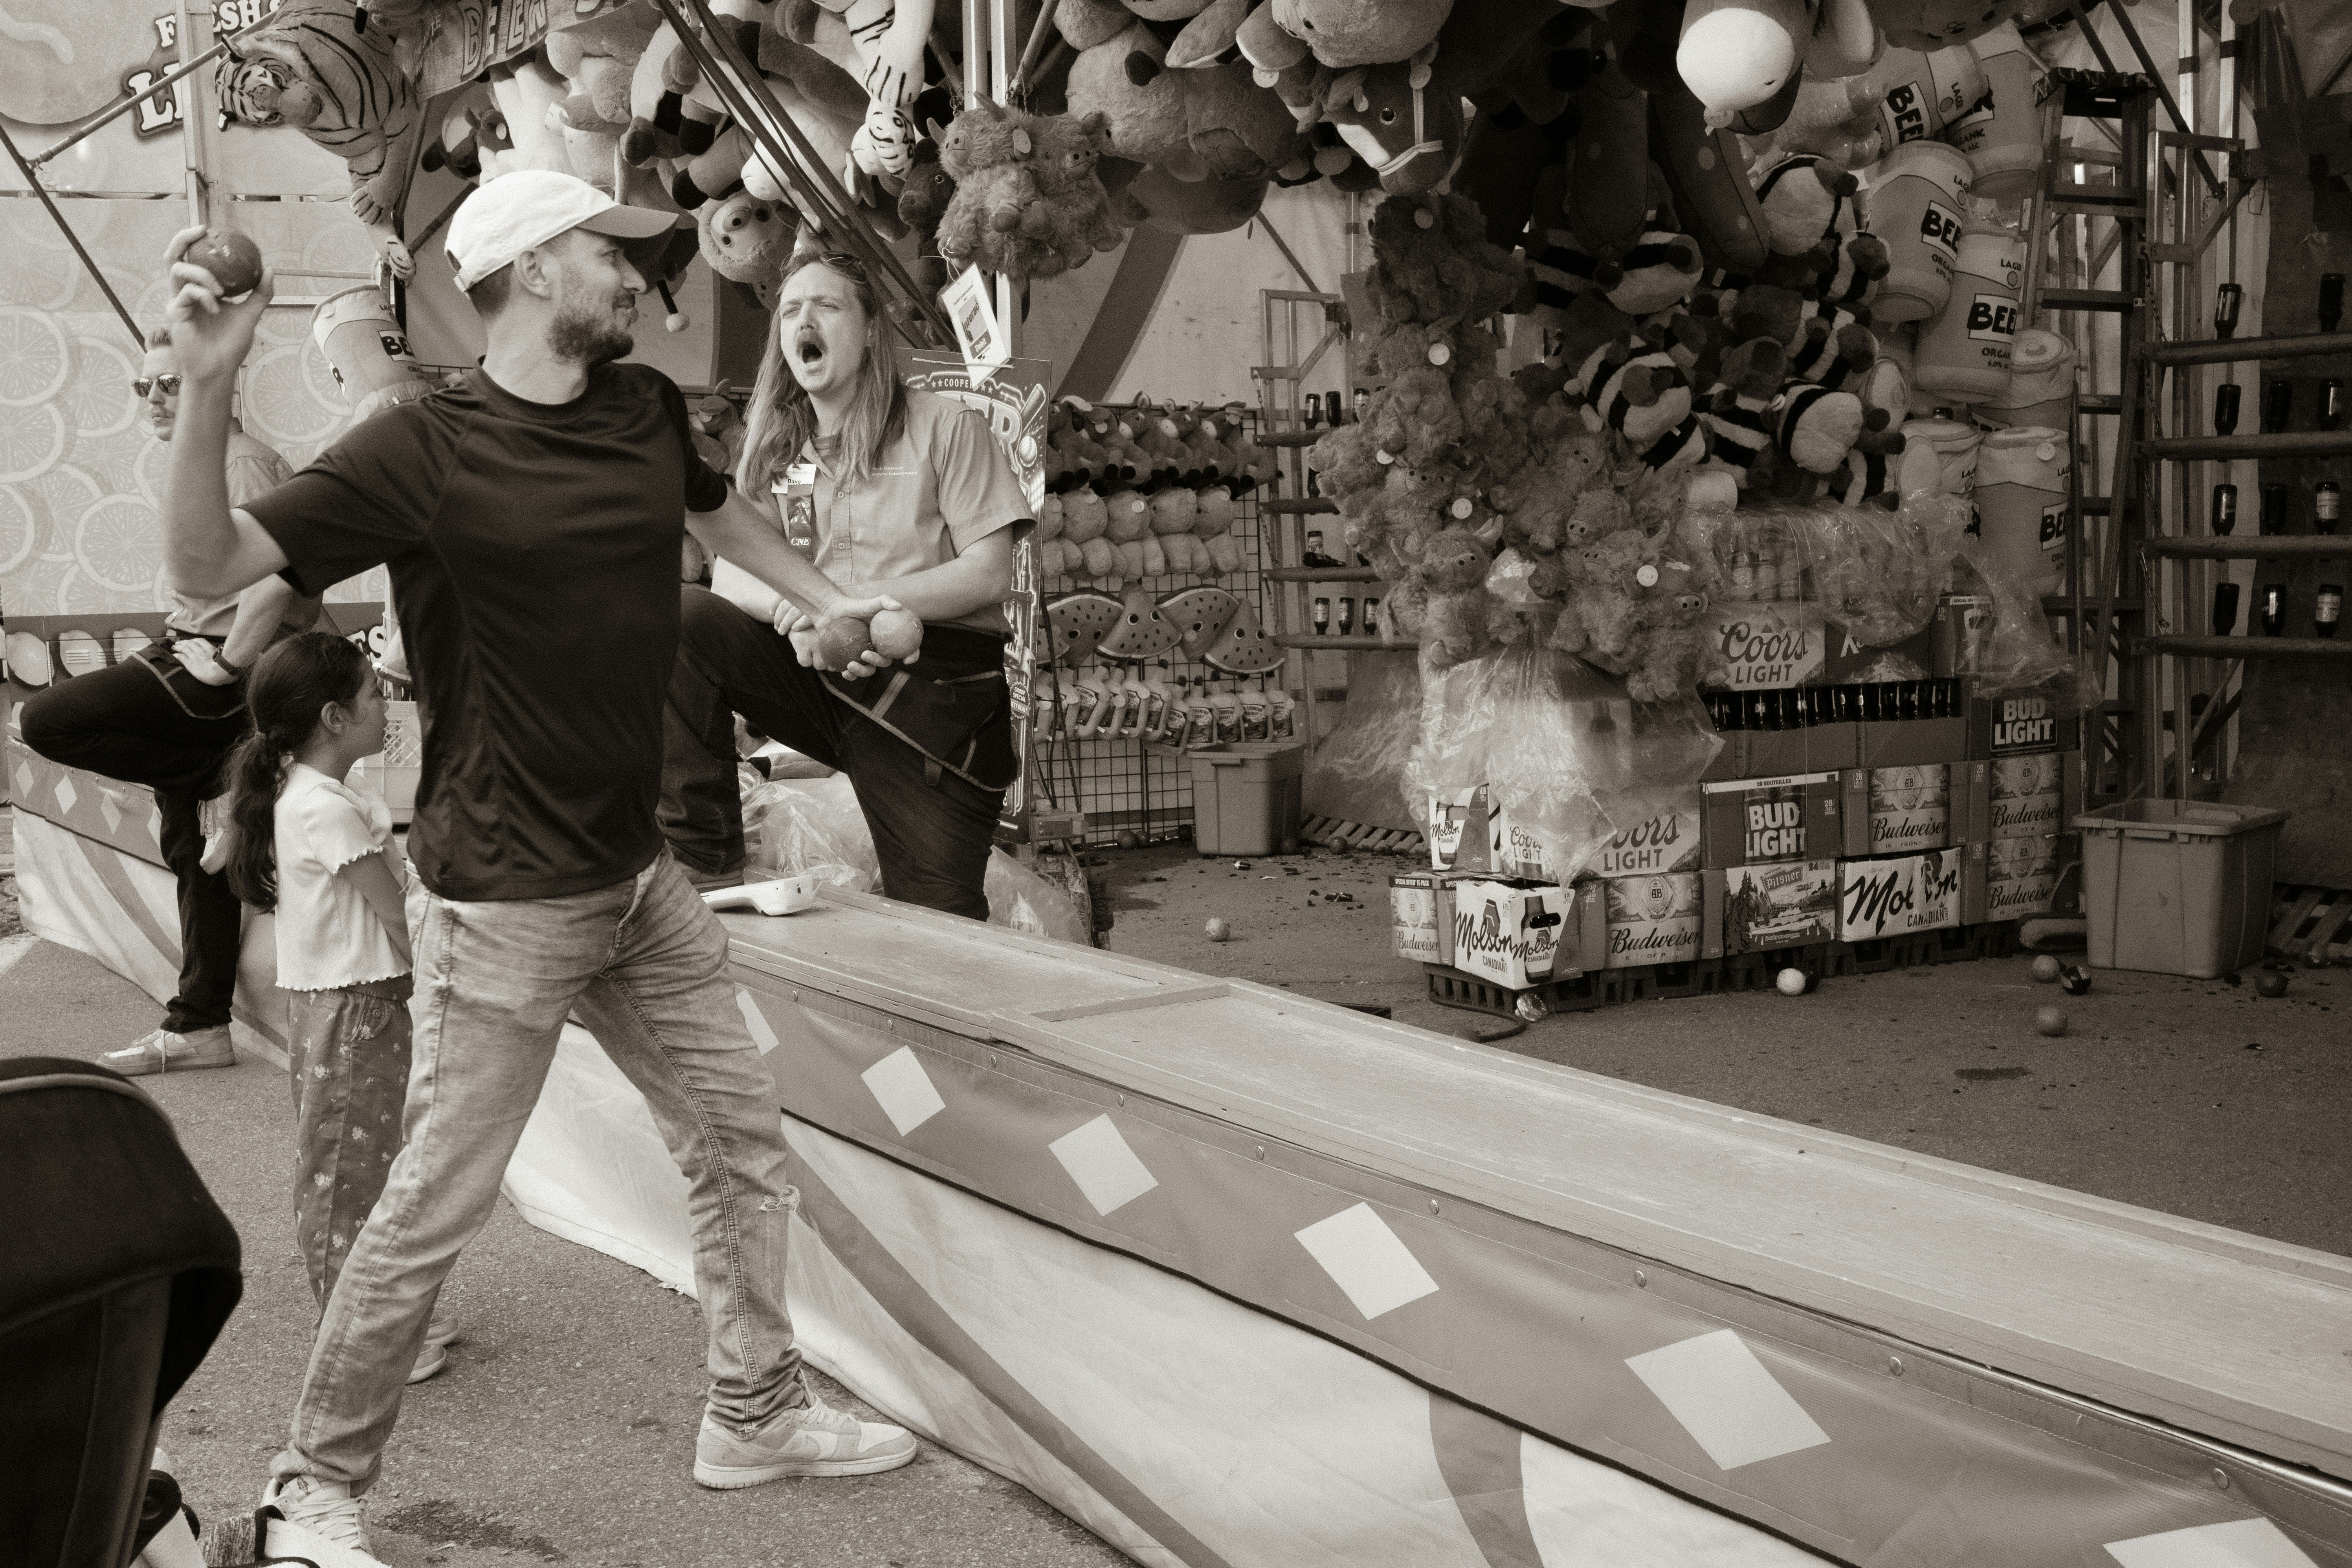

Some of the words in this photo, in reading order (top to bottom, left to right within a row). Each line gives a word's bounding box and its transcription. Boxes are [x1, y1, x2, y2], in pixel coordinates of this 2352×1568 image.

[1886, 85, 1924, 145] BEE
[1921, 209, 1961, 254] BEE
[1967, 303, 2016, 336] BEE
[975, 337, 987, 352] Debit
[791, 537, 809, 546] CNE
[1719, 622, 1808, 664] Coors
[1736, 664, 1792, 684] LIGHT
[1013, 692, 1026, 702] SPECIAL
[1014, 686, 1026, 695] GROUP
[2003, 698, 2045, 722] BUD
[1994, 719, 2053, 745] LIGHT
[1856, 772, 1862, 780] 28
[1748, 801, 1800, 831] BUD
[1430, 823, 1460, 842] Molson
[1872, 816, 1946, 842] Budweiser
[1514, 847, 1542, 860] LIGHT
[1745, 827, 1806, 857] LIGHT
[1604, 848, 1663, 871] LIGHT
[1808, 862, 1818, 871] 24
[1767, 870, 1800, 889] Pilsner
[1989, 884, 2053, 909] Budweise
[1907, 907, 1944, 928] CANADIAN
[1396, 930, 1438, 952] Budweiser
[1455, 910, 1512, 963] Molson
[1611, 927, 1698, 954] Budweiser
[1511, 939, 1559, 963] Molson
[1482, 955, 1505, 973] CANADIAN
